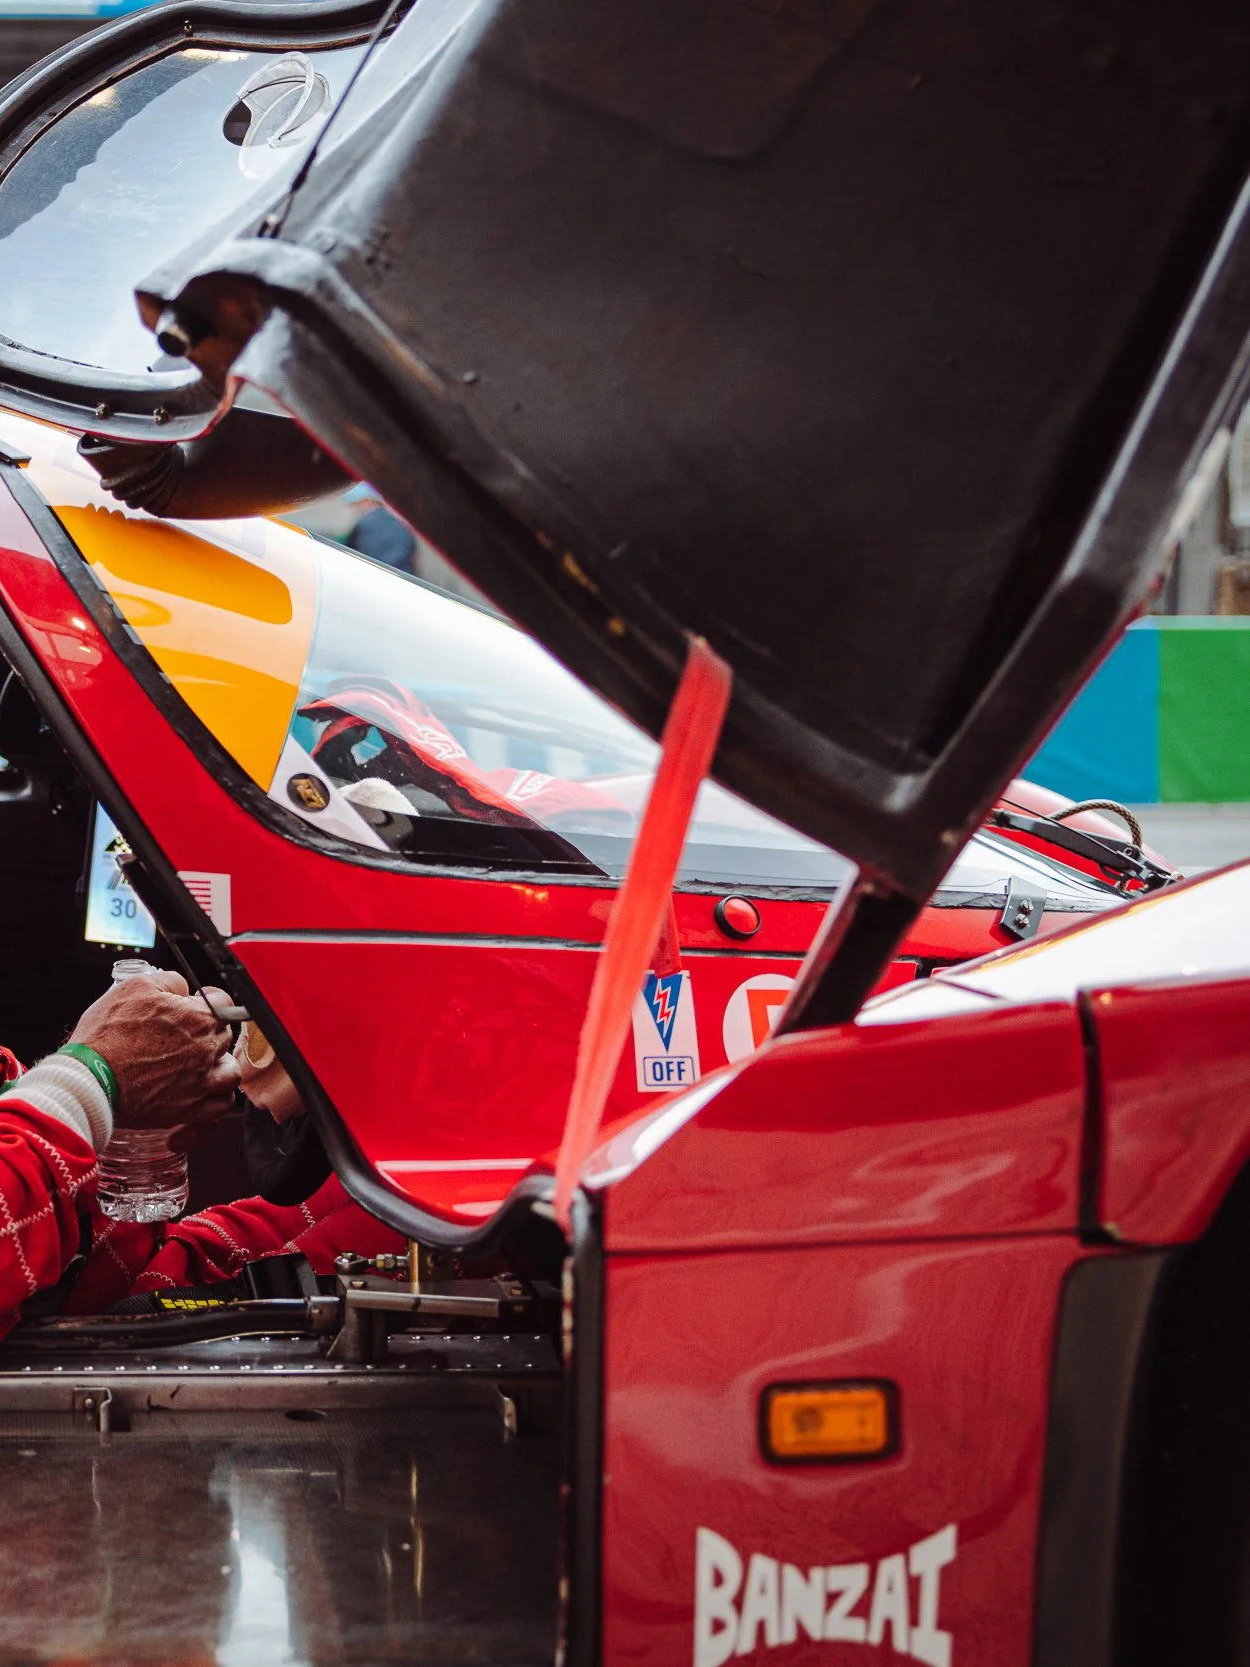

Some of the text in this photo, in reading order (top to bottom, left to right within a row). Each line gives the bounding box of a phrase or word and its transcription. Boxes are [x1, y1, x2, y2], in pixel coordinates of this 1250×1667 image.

[110, 898, 137, 919] 30
[652, 1061, 686, 1081] OFF
[694, 1523, 958, 1667] BANZAI
